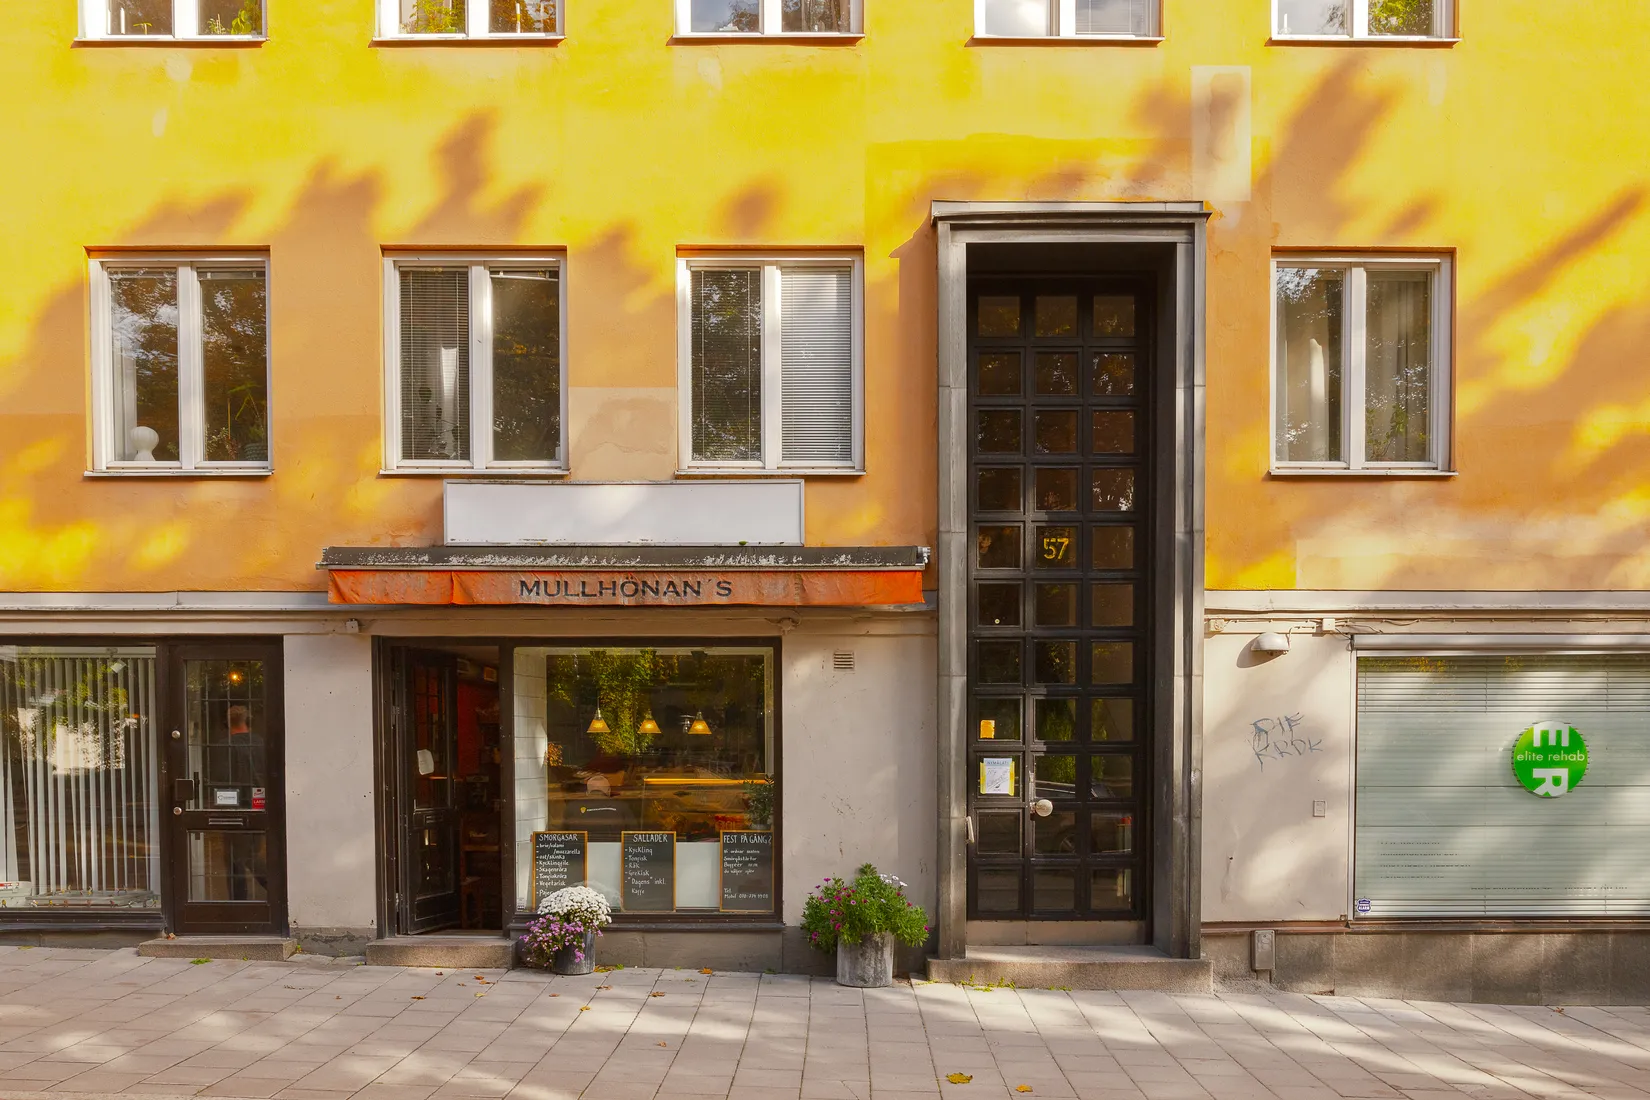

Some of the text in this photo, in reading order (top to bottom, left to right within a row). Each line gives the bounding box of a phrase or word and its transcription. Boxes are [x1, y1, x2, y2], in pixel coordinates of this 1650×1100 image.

[1043, 537, 1069, 559] 57
[1516, 750, 1585, 761] elite rehab
[632, 834, 668, 842] SALLADER
[723, 834, 737, 843] FEST
[740, 833, 748, 843] PÅ
